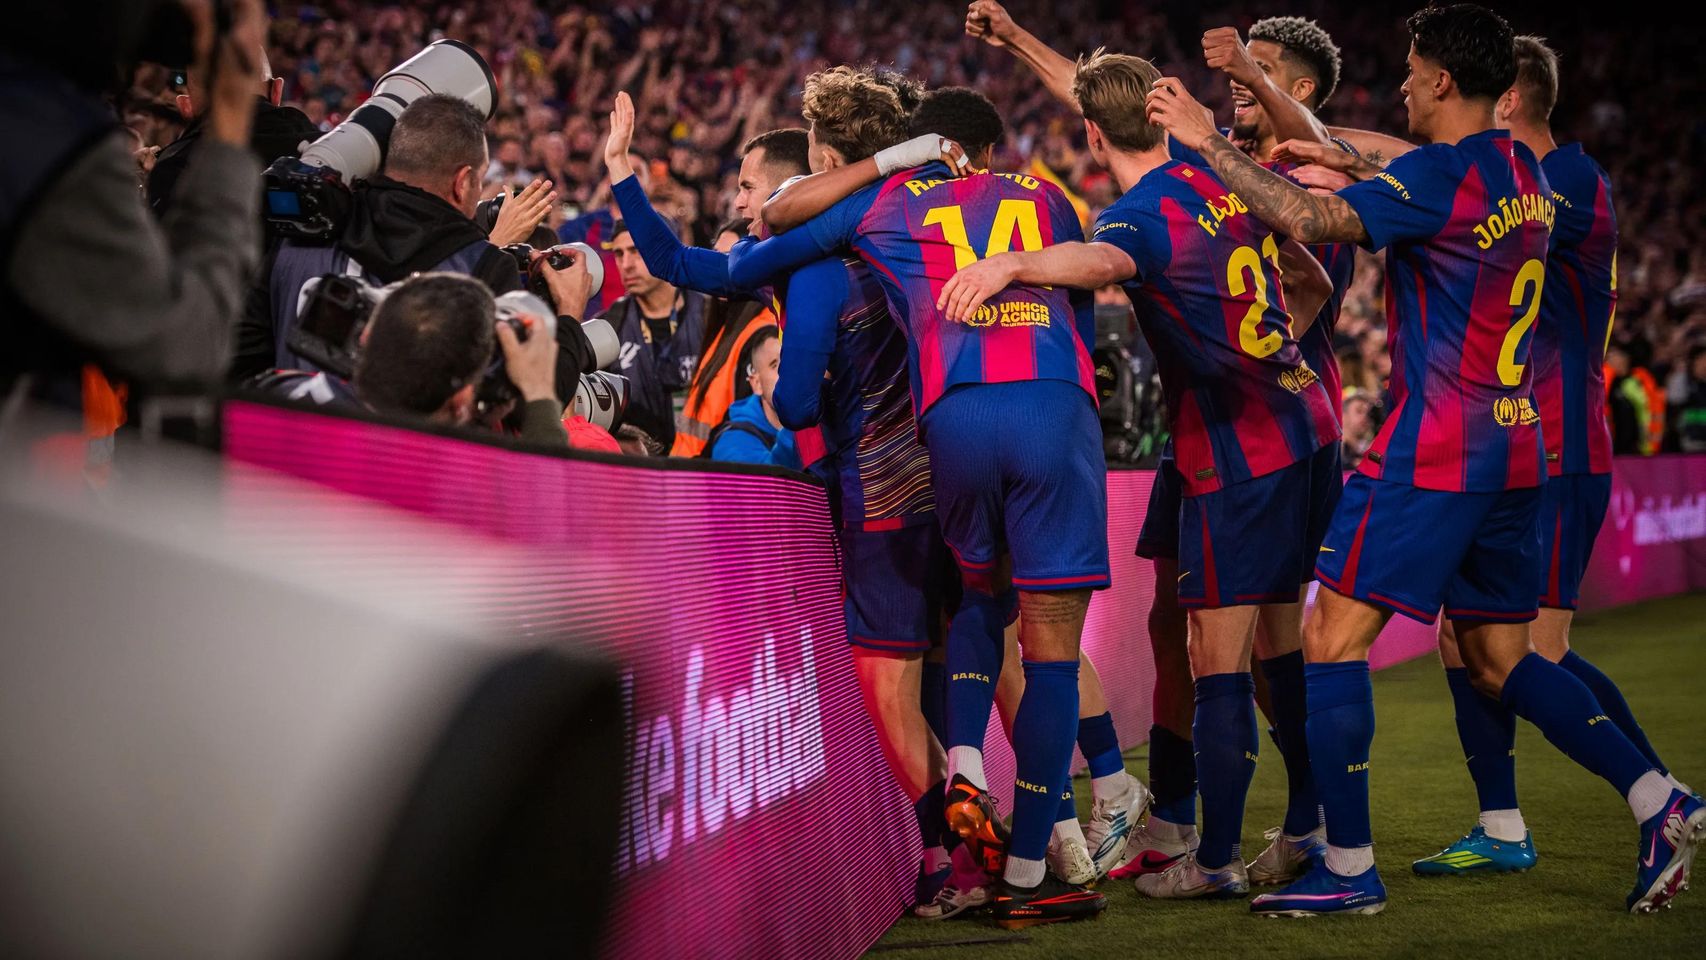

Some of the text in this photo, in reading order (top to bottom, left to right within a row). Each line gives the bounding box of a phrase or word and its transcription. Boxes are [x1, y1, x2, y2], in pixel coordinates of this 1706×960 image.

[922, 199, 1053, 291] 14
[1472, 196, 1523, 250] JOÃO
[1000, 301, 1049, 315] UNHCR
[1000, 312, 1050, 325] ACNUR
[1496, 258, 1545, 386] 2
